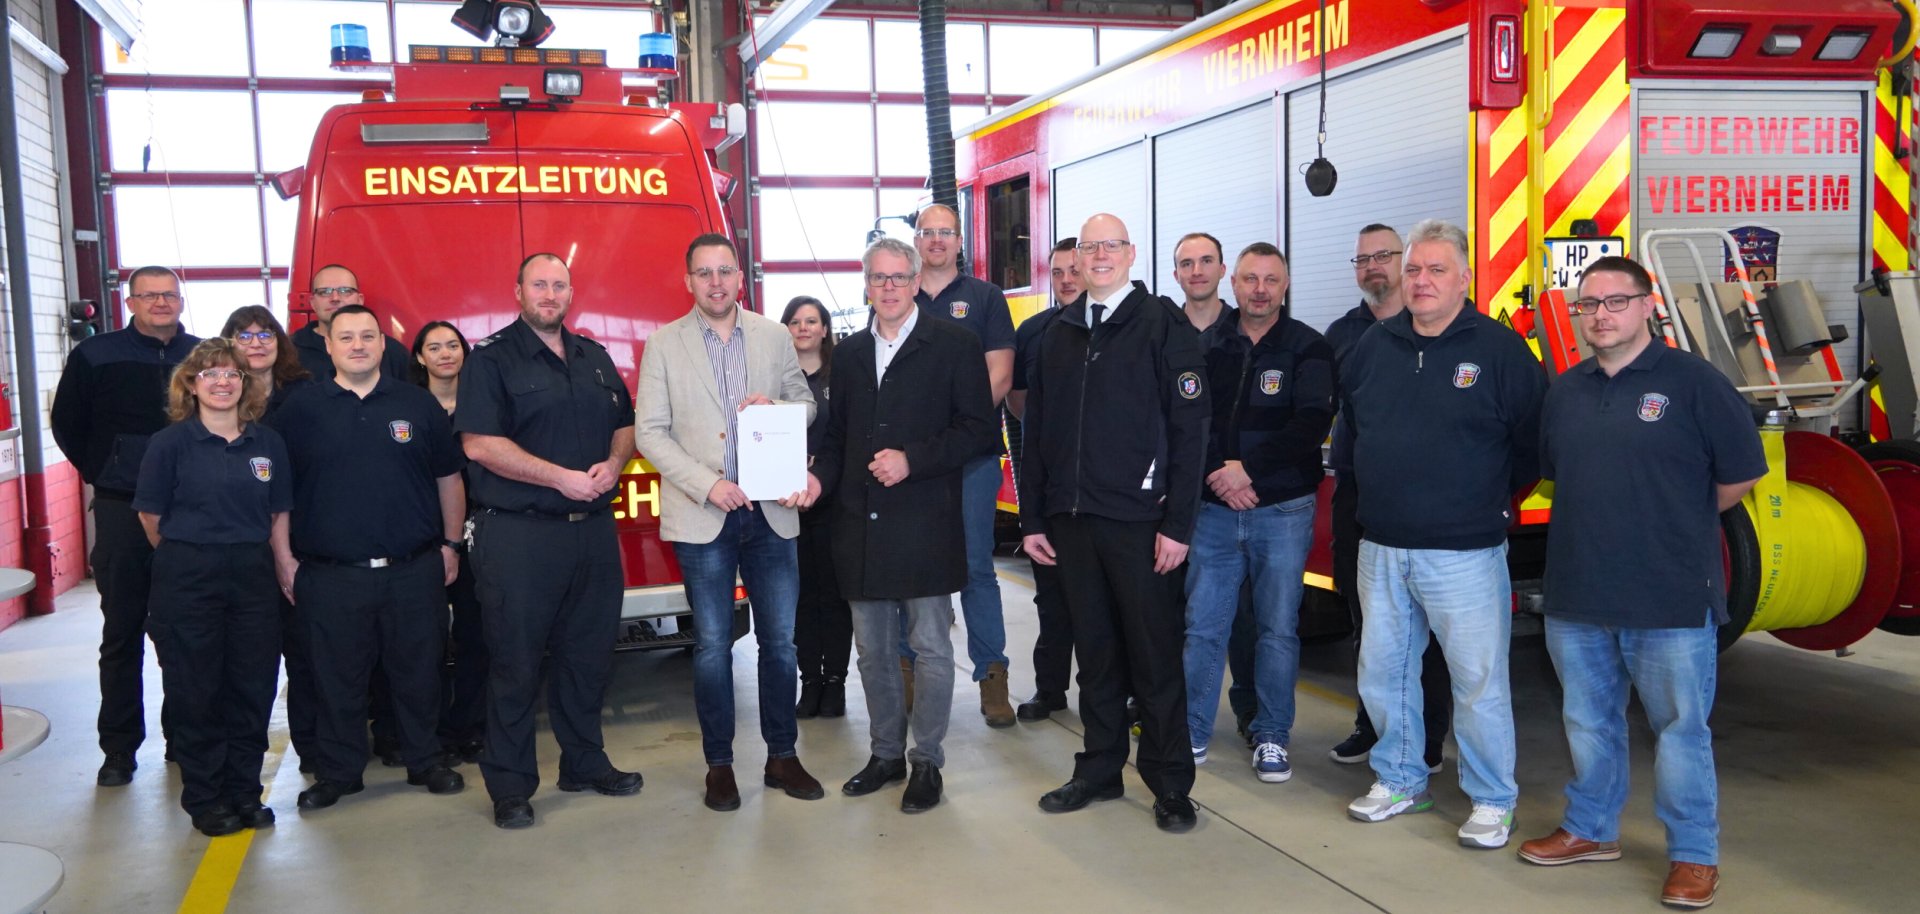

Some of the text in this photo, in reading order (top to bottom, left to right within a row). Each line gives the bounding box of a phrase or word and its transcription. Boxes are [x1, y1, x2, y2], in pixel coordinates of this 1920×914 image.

[1203, 1, 1348, 94] VIERNHEIM
[1640, 117, 1859, 154] FEUERWEHR
[365, 166, 668, 196] EINSATZLEITUNG
[1647, 174, 1849, 213] VIERNHEIM
[1566, 245, 1588, 267] HP
